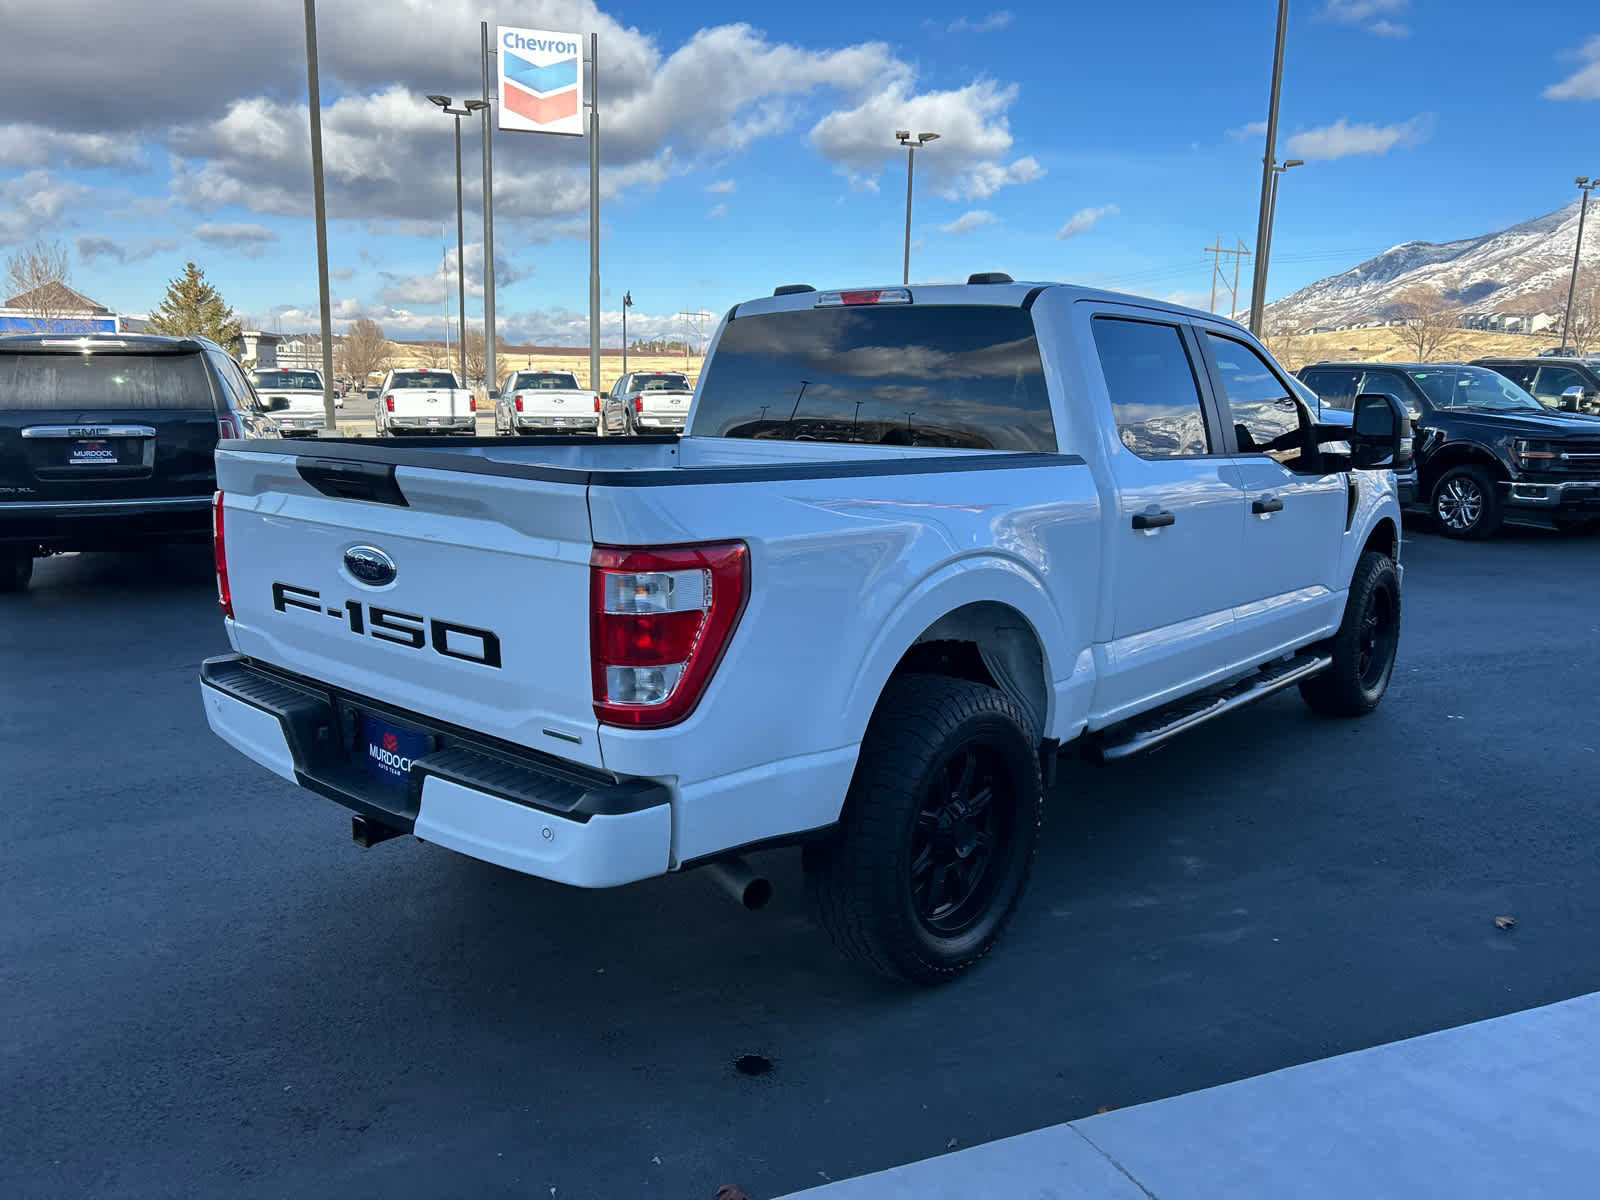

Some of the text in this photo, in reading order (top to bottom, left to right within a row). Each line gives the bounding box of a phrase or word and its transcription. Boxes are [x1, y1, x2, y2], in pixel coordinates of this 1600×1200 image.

[503, 32, 577, 54] Chevron
[68, 428, 108, 436] GMC
[272, 581, 502, 669] F-150
